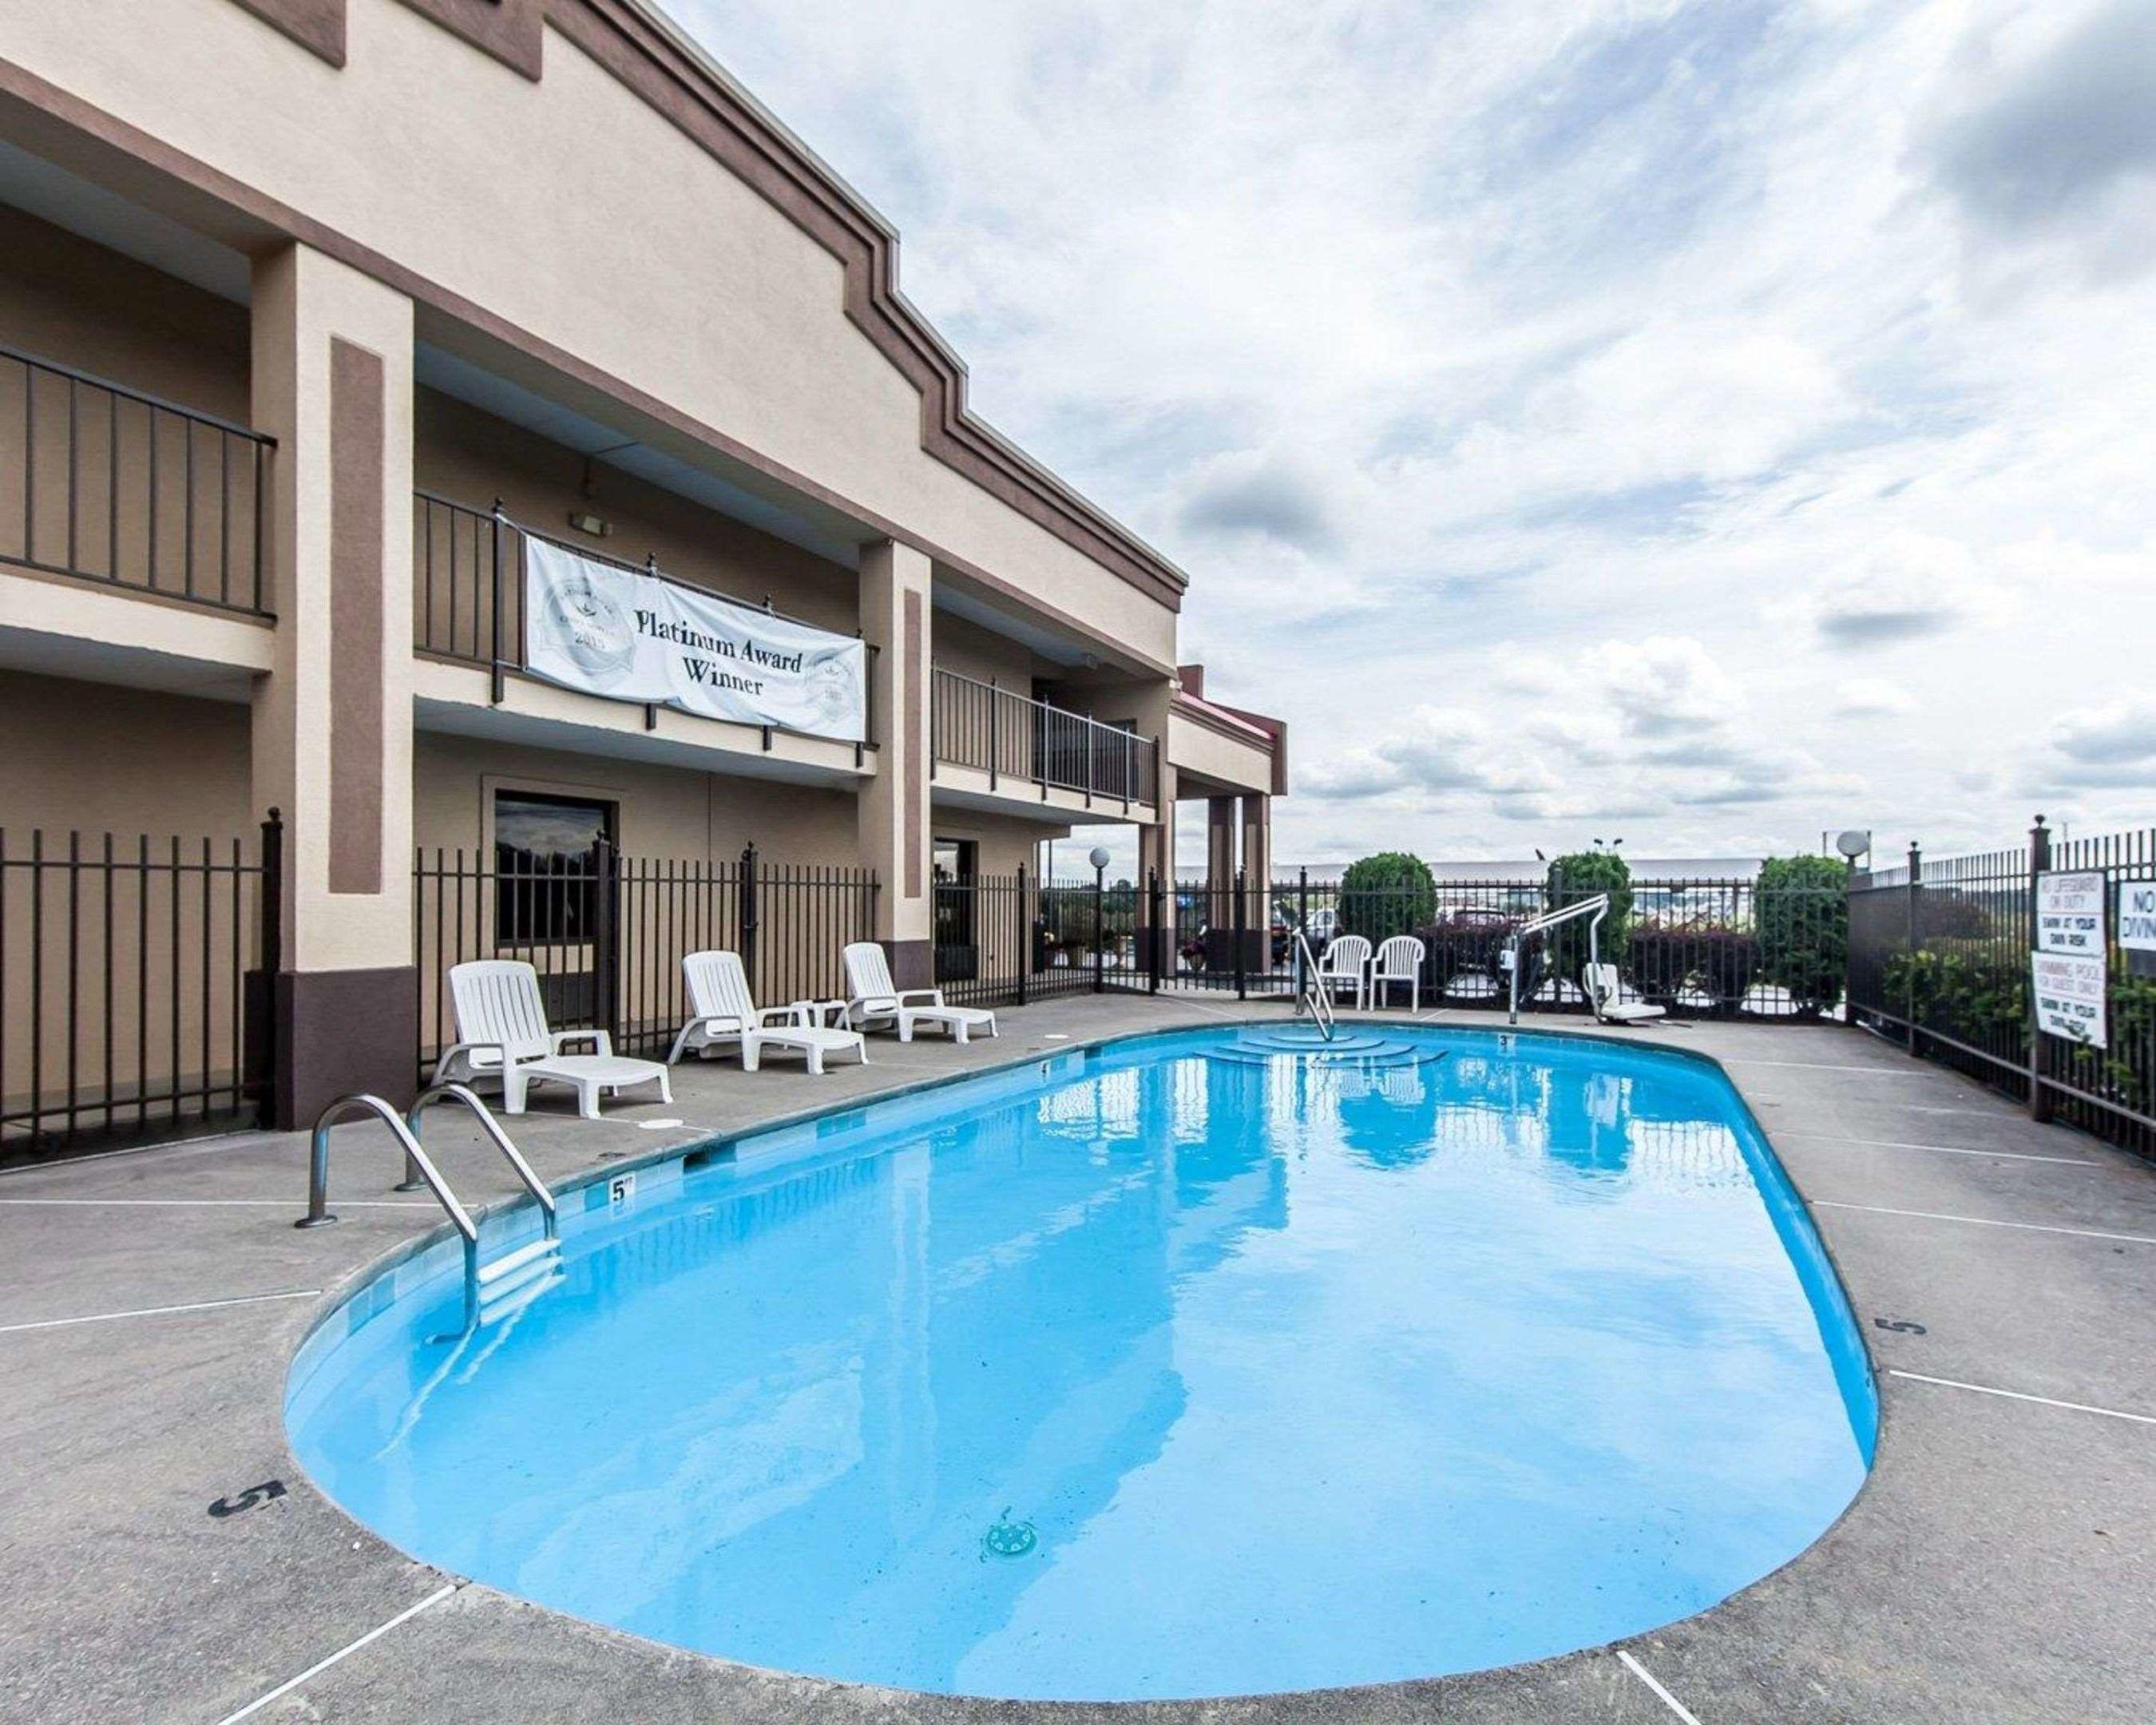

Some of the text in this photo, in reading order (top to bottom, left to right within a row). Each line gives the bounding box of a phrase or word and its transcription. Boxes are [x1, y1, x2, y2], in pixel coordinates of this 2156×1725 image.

[634, 609, 736, 658] Platinum
[740, 640, 803, 672] Award
[684, 656, 763, 696] Winner
[2134, 890, 2155, 913] NO
[612, 1180, 624, 1201] 5
[208, 1480, 287, 1517] 5
